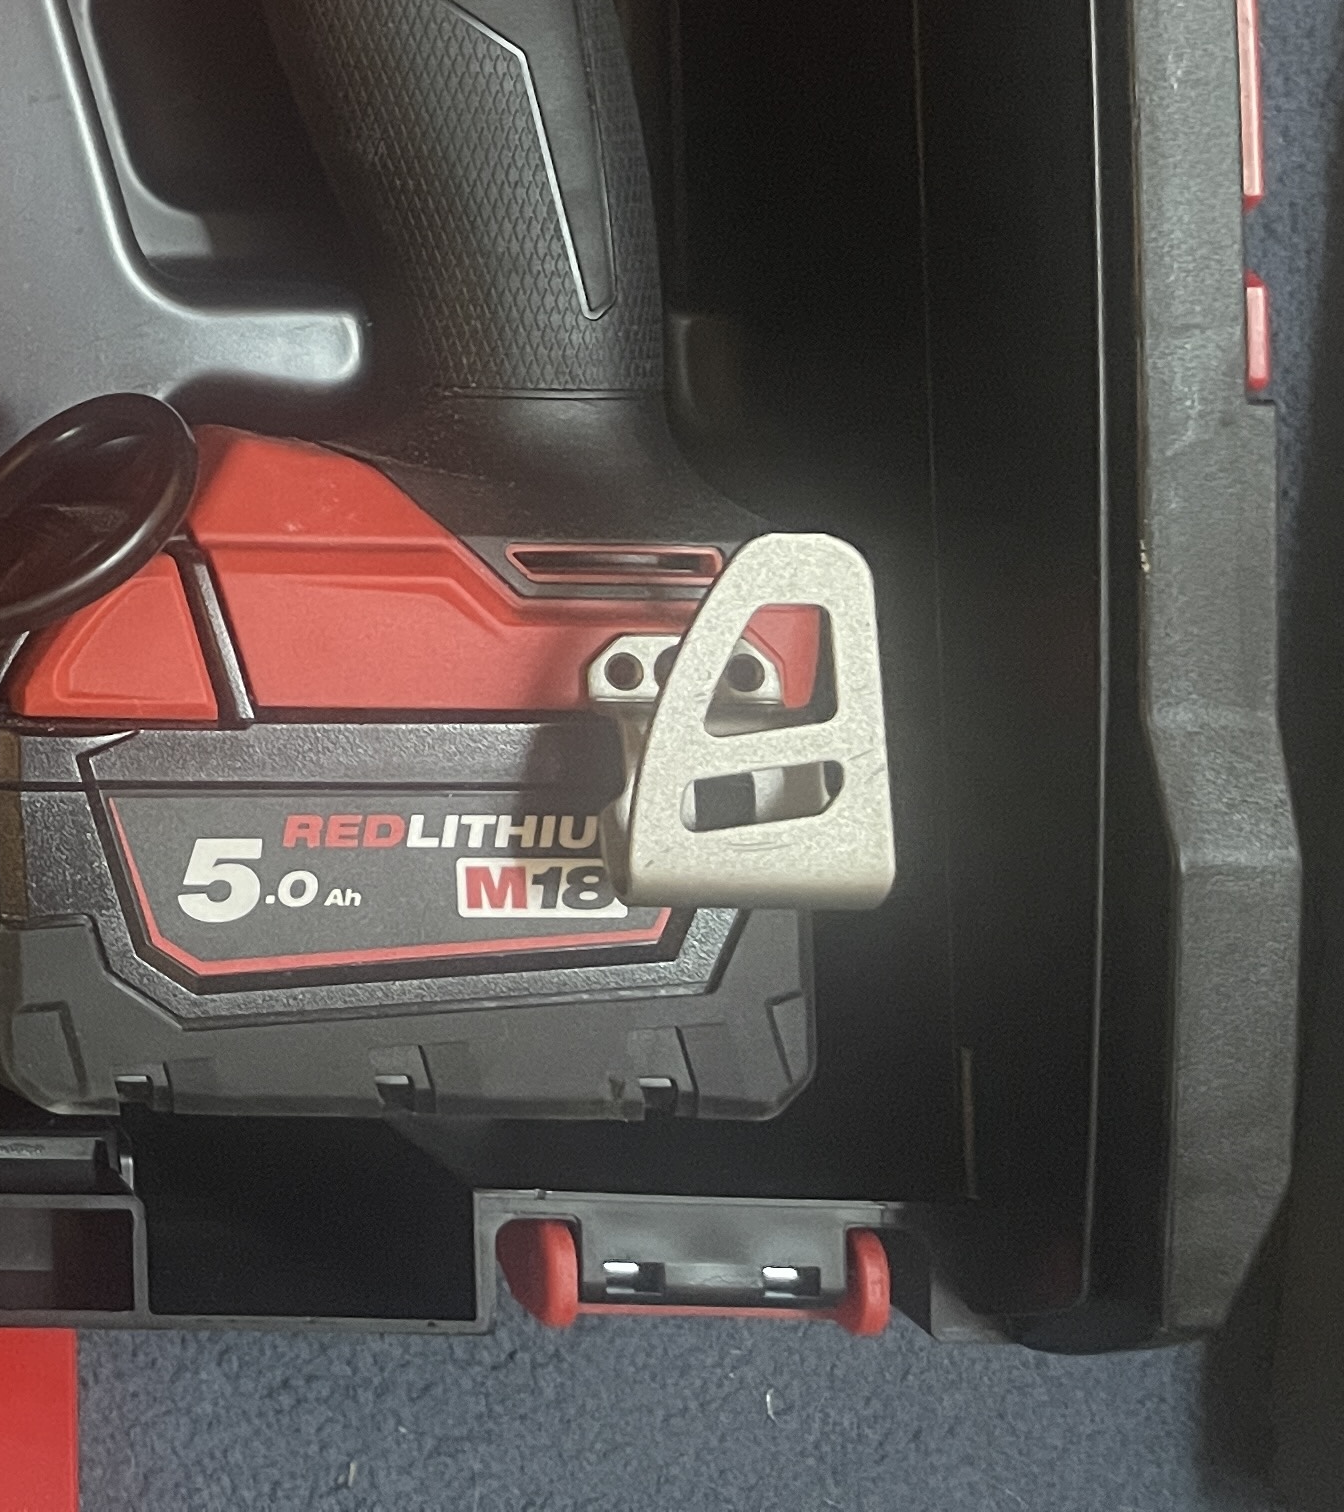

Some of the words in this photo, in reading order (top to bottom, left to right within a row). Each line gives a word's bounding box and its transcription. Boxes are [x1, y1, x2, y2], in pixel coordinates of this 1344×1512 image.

[281, 813, 600, 850] REDLITHIU
[177, 838, 319, 923] 5.0
[323, 888, 362, 907] Ah
[464, 865, 617, 911] M18
